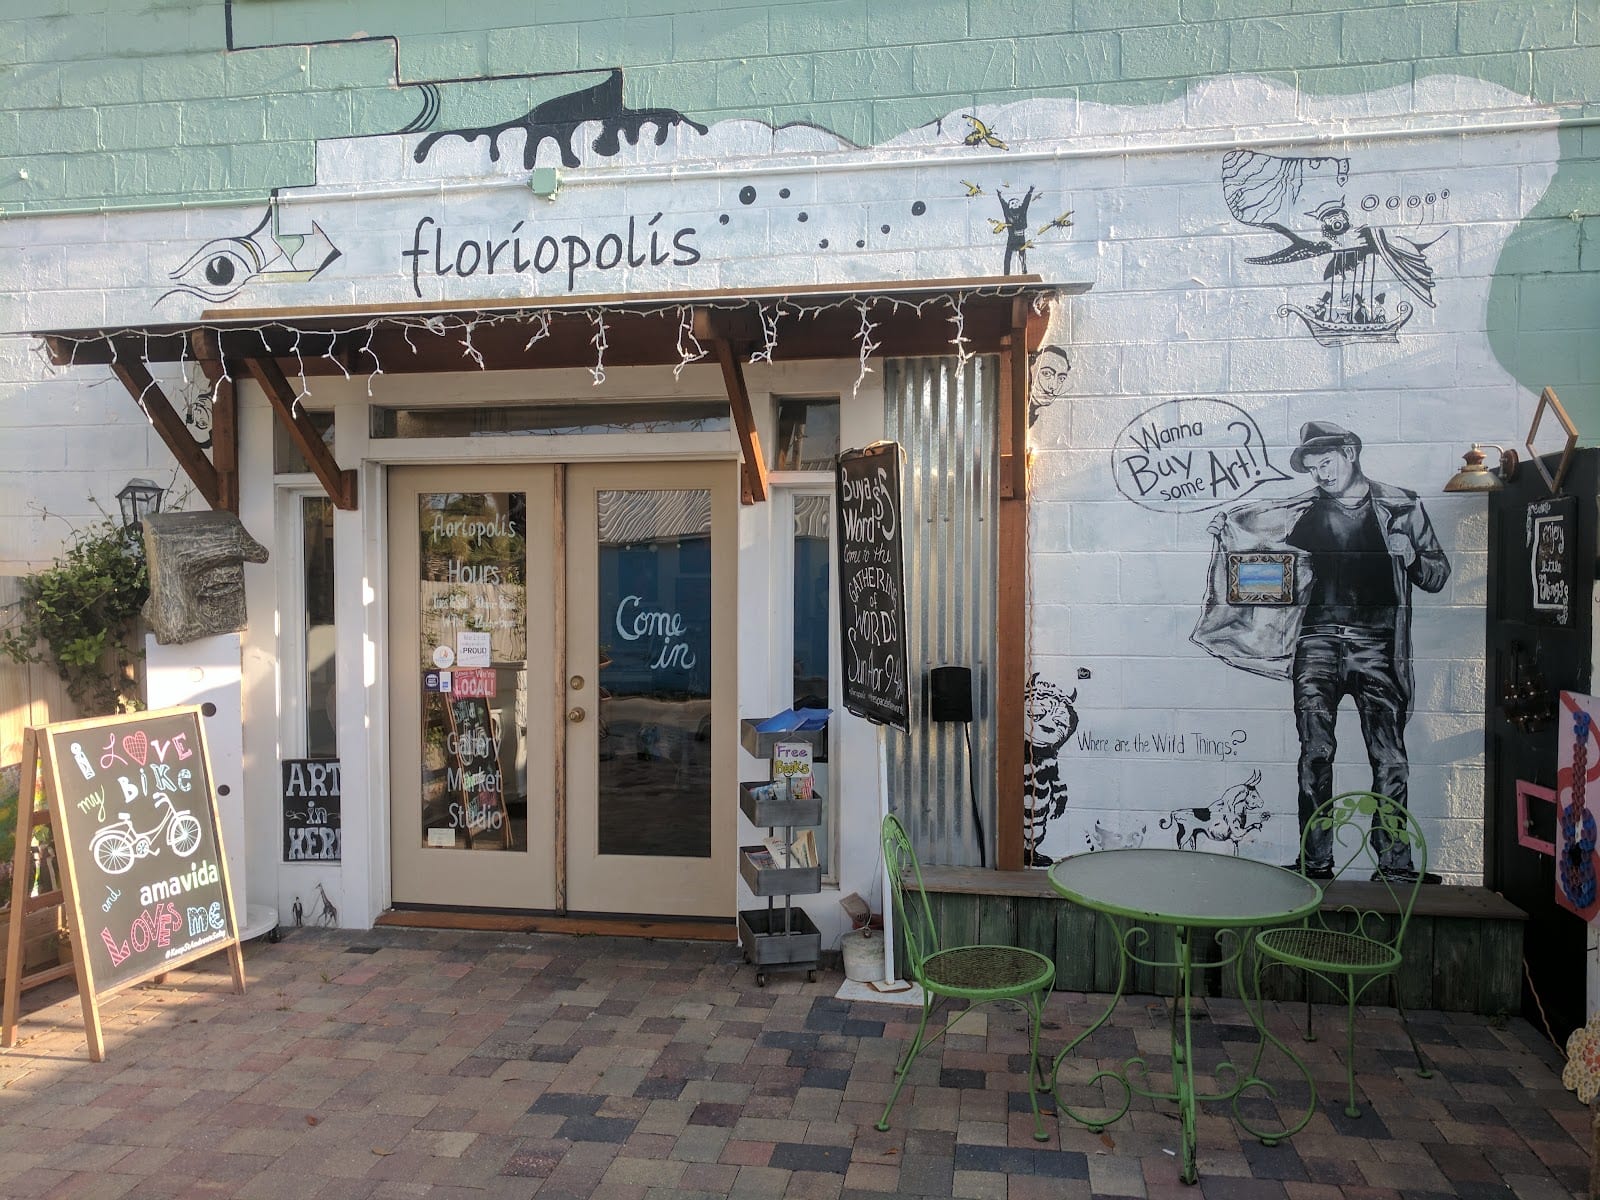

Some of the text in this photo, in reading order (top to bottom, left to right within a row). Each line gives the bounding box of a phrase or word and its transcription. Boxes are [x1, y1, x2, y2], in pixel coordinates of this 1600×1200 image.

[1129, 421, 1203, 454] Wanna
[1121, 450, 1193, 496] Buy
[1160, 477, 1205, 501] some
[430, 512, 517, 546] floriopolis
[842, 507, 875, 544] Word
[873, 543, 892, 564] the
[448, 560, 501, 585] Hours
[848, 566, 898, 610] GATHERING
[869, 591, 878, 609] of
[616, 595, 687, 640] Come
[854, 604, 897, 647] WORDS
[462, 646, 487, 655] PROUD
[650, 636, 696, 670] in
[847, 626, 867, 686] Sun
[454, 678, 494, 696] LOCAL!
[776, 745, 808, 758] Free
[1077, 729, 1247, 762] Where are the Wild Things?
[286, 763, 341, 797] ART
[447, 766, 502, 792] Market
[775, 760, 811, 775] Books
[77, 784, 106, 822] my
[306, 800, 328, 825] in
[448, 802, 503, 830] Studio
[102, 859, 219, 913] and amavida
[101, 902, 183, 967] LOVES
